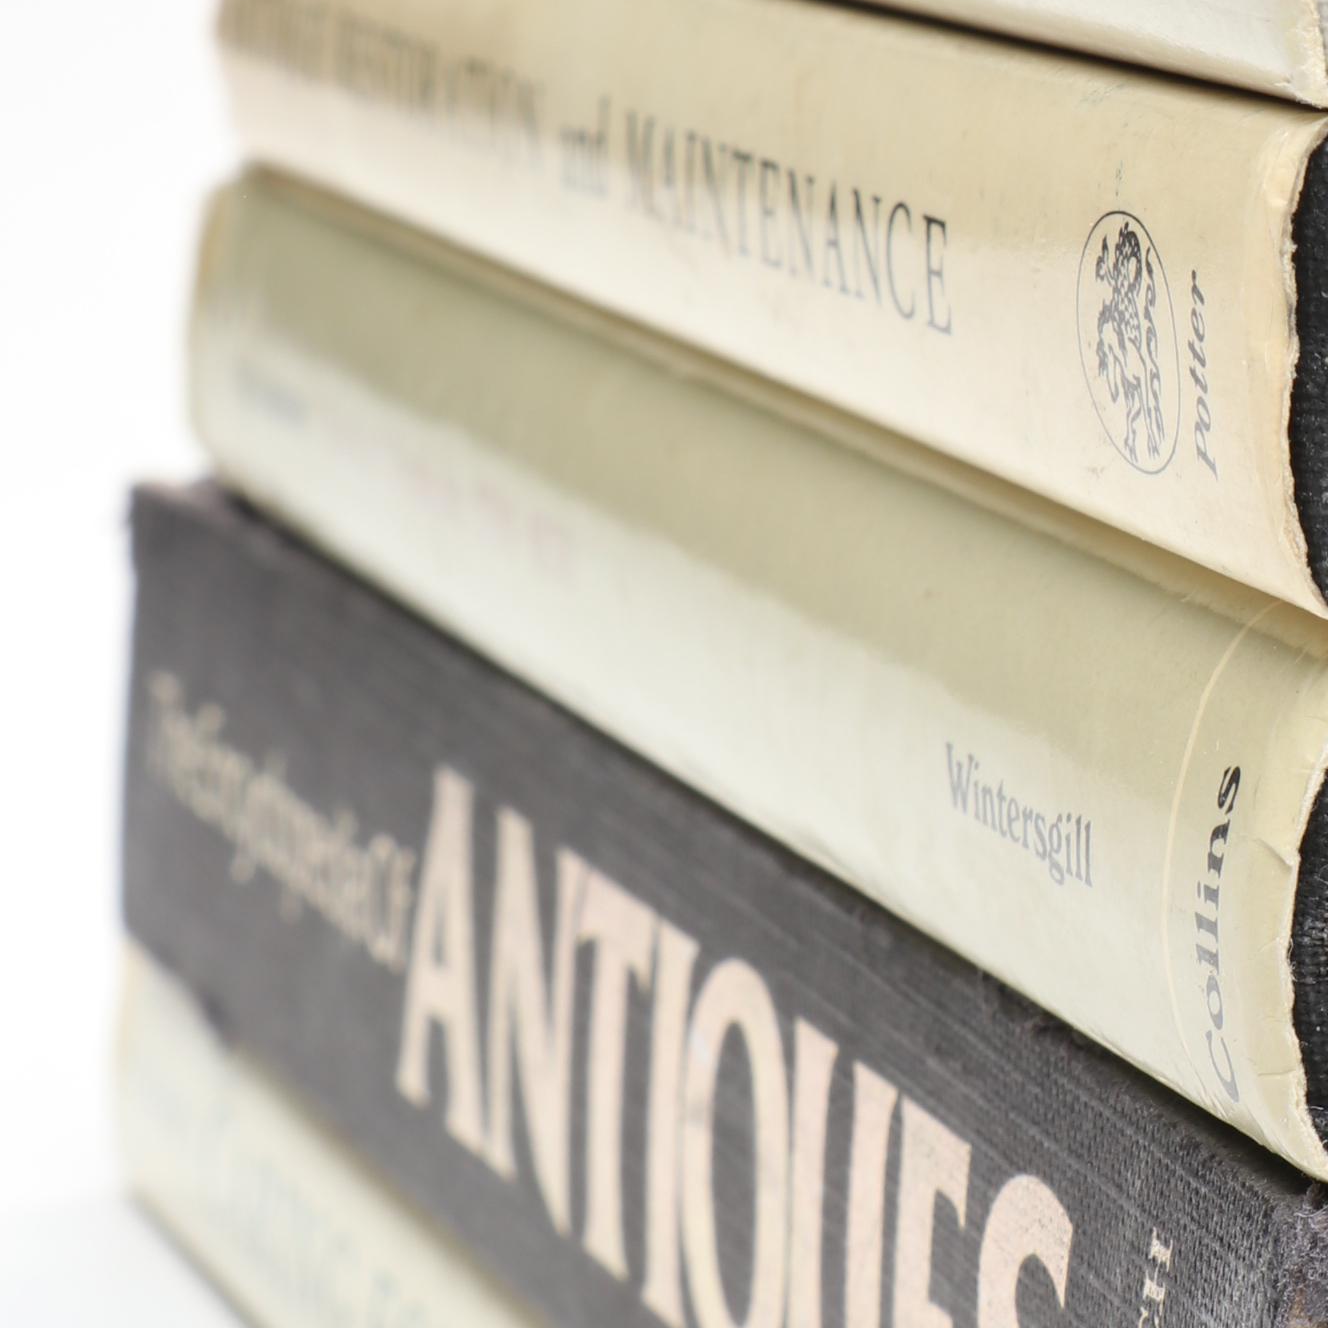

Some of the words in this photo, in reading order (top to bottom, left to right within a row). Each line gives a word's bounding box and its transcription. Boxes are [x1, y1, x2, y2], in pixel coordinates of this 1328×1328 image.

[625, 107, 953, 336] MAINTENANCE
[1187, 268, 1218, 482] Potter
[945, 741, 1093, 889] Wintersgill
[1194, 764, 1242, 1104] Collins
